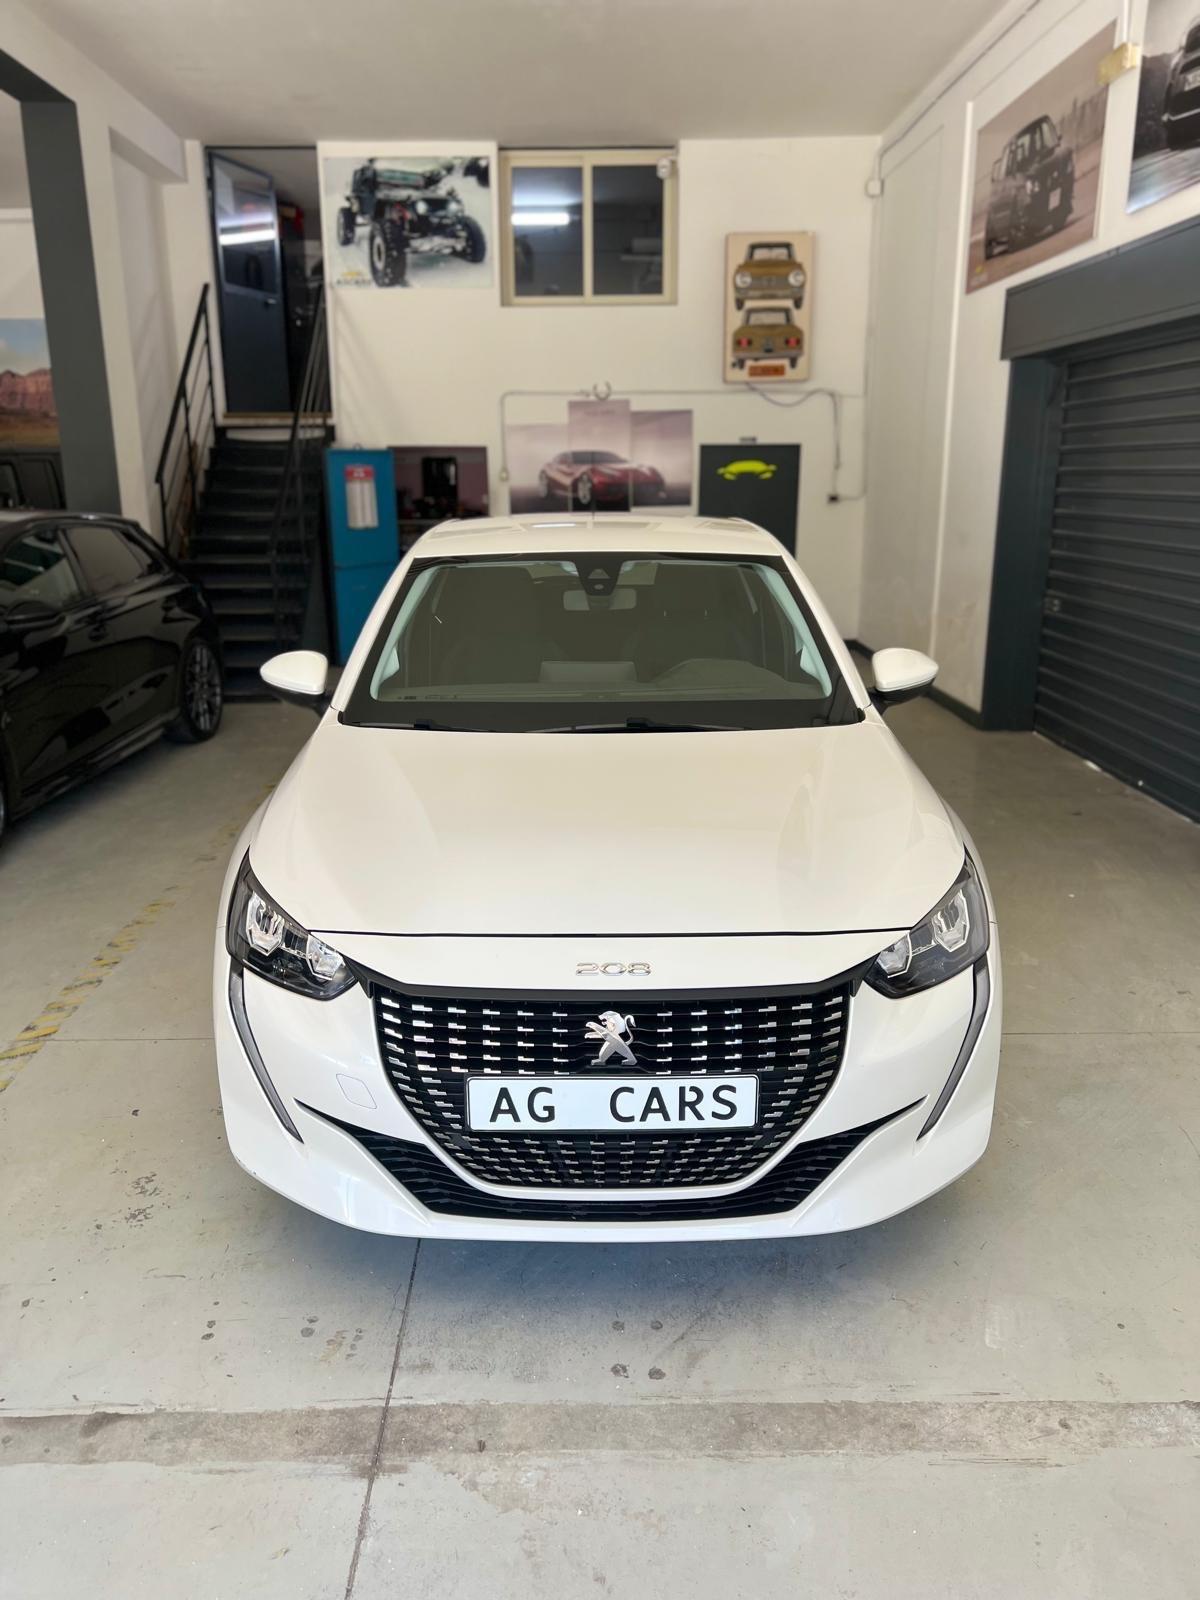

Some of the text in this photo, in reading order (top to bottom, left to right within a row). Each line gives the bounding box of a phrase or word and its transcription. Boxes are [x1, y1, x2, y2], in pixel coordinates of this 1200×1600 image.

[576, 963, 651, 976] 208
[489, 1085, 738, 1123] AG CARS
